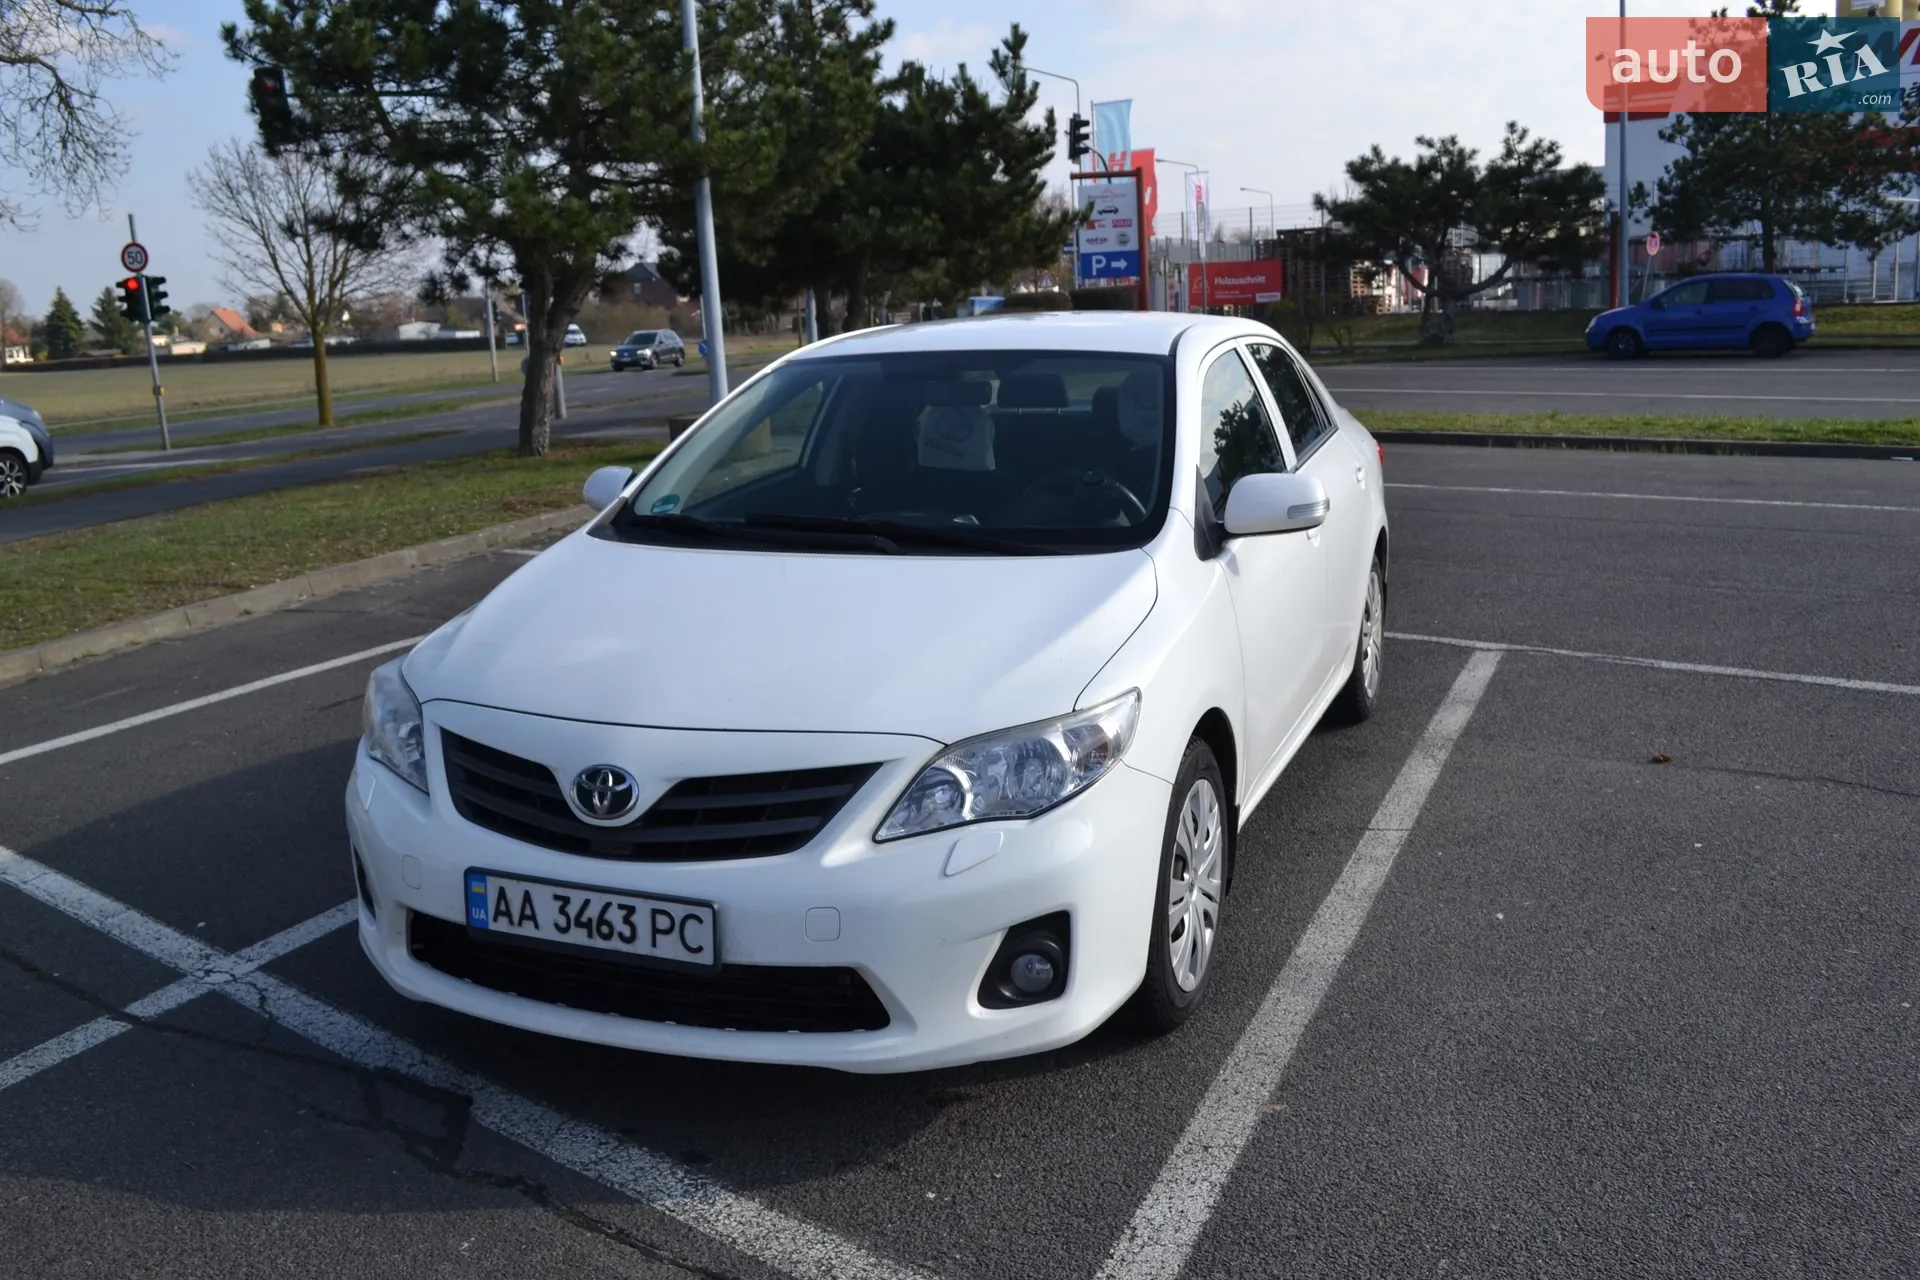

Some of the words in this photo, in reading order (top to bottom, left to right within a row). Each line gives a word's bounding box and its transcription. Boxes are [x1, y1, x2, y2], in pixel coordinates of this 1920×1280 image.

[127, 251, 143, 265] 50
[1092, 255, 1106, 276] P
[1214, 275, 1266, 285] Holzzuschnitt
[472, 906, 487, 921] UA
[492, 885, 540, 930] AA
[552, 893, 637, 945] 3463
[650, 907, 705, 954] PC
